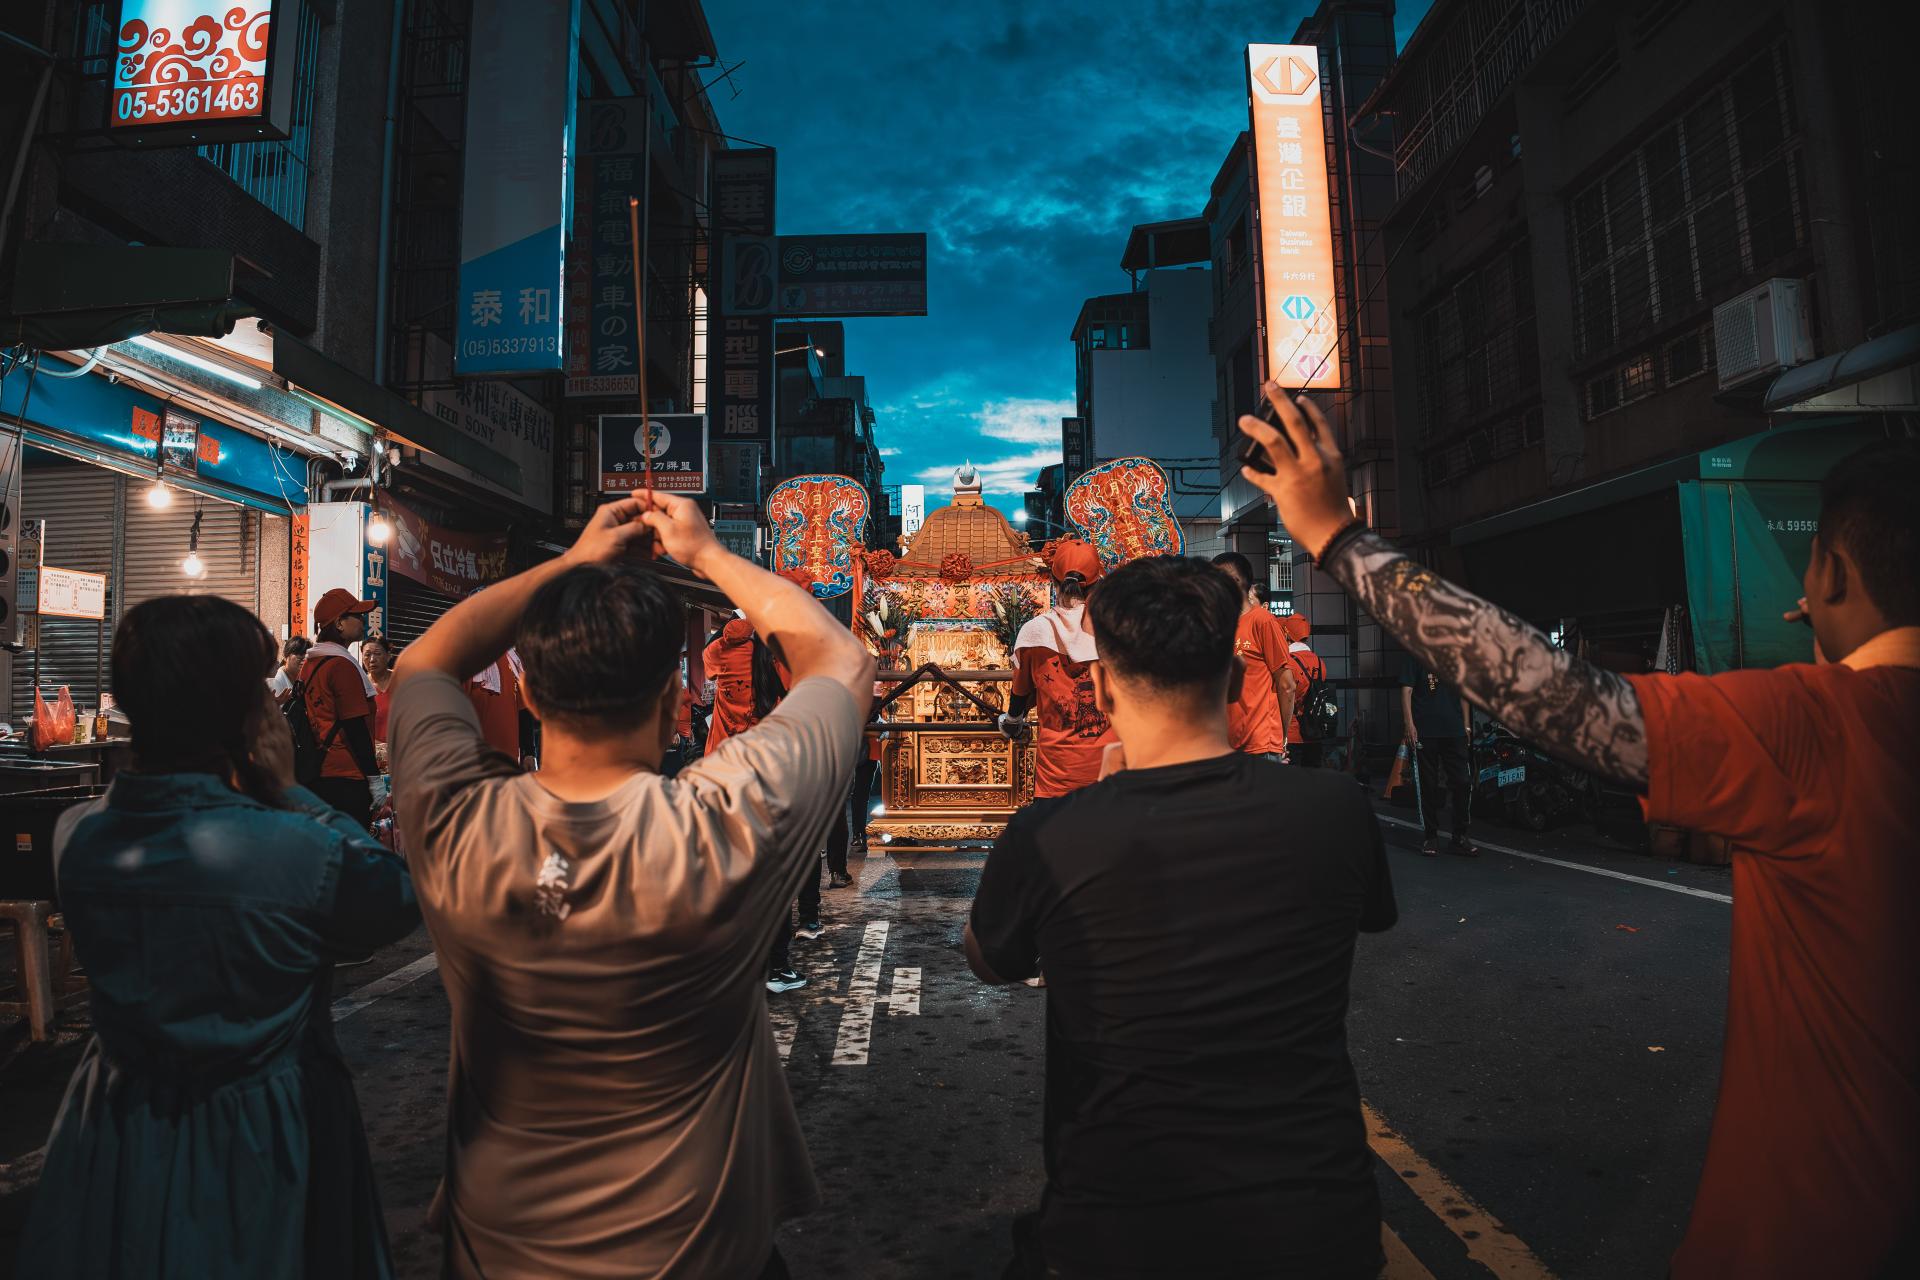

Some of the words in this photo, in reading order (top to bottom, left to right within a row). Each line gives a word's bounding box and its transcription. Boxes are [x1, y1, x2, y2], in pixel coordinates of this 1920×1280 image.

[118, 81, 260, 120] 05-5361463
[1280, 229, 1307, 238] Taiwan
[1280, 238, 1313, 246] Business
[1280, 246, 1300, 255] Bank
[1282, 272, 1317, 281] 斗六分行
[471, 287, 552, 328] 泰和
[463, 335, 556, 358] (05)5337913
[464, 414, 496, 443] SONY
[811, 514, 825, 576] 天上聖母
[430, 540, 479, 581] 日立冷氣
